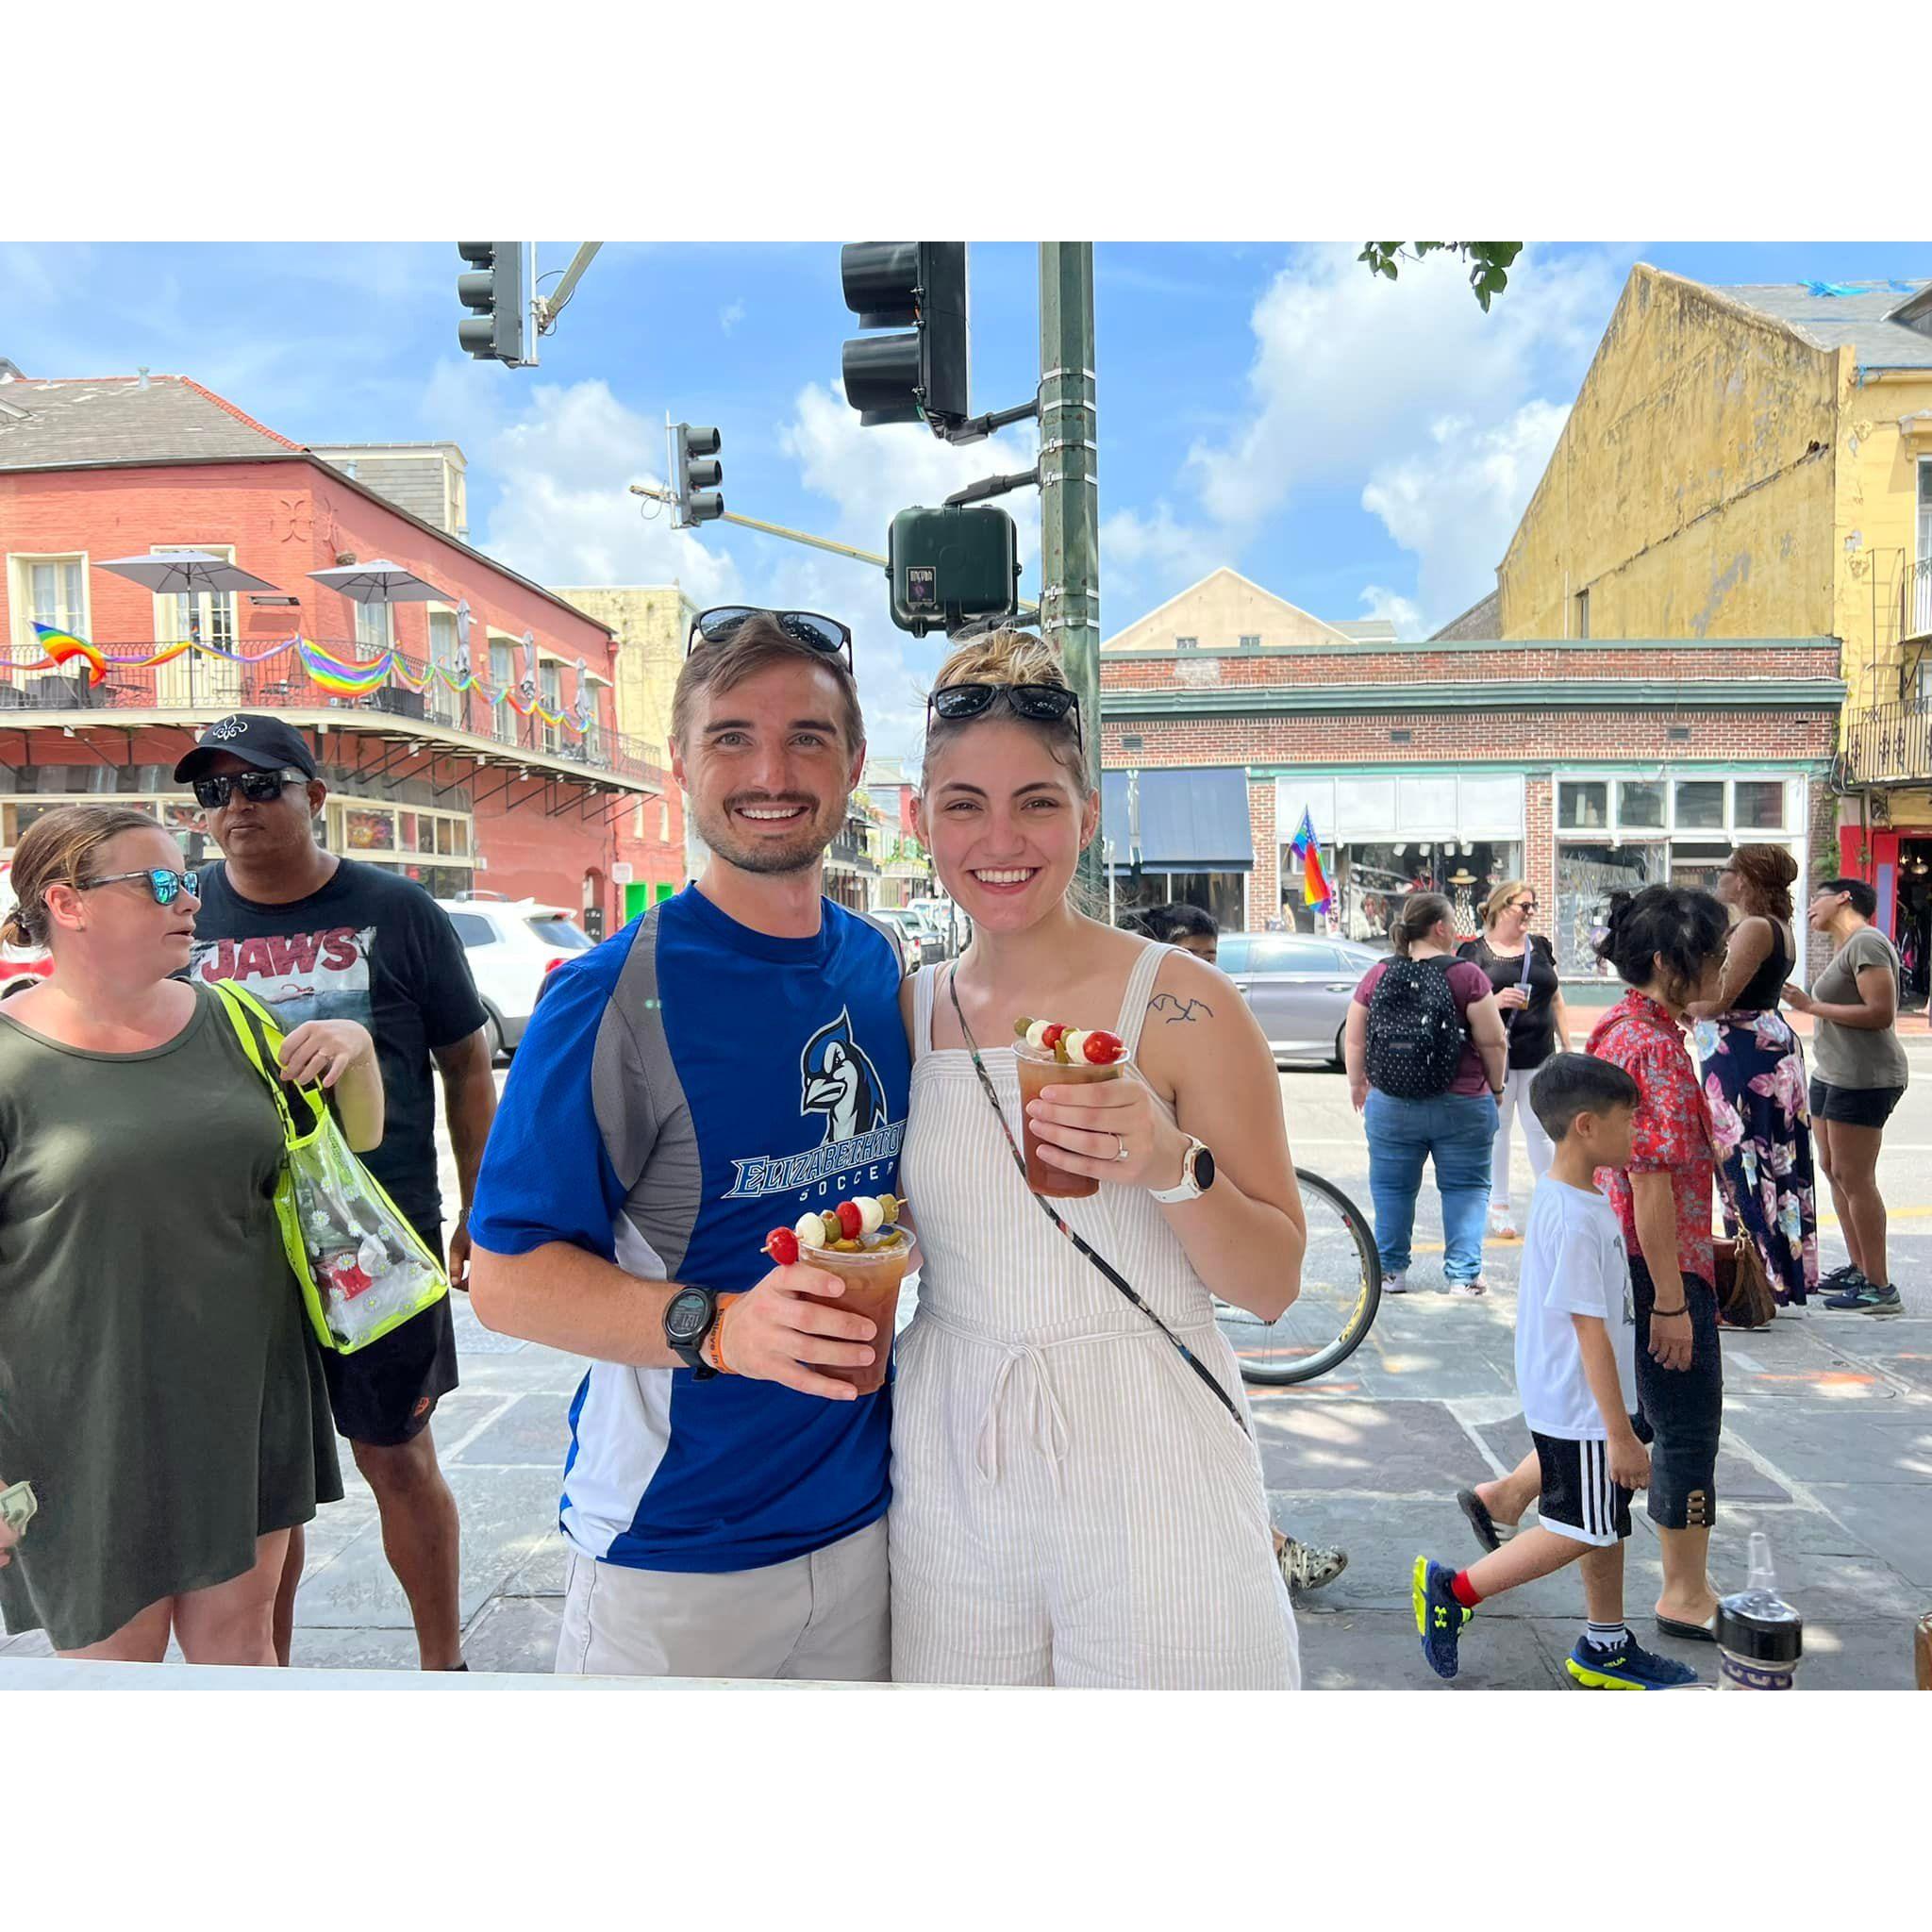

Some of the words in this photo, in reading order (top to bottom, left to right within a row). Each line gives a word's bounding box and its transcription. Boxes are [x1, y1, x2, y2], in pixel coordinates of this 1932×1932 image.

[201, 926, 358, 985] JAWS
[721, 1119, 908, 1199] ELIZABETHTO
[799, 1161, 894, 1202] SOCCER
